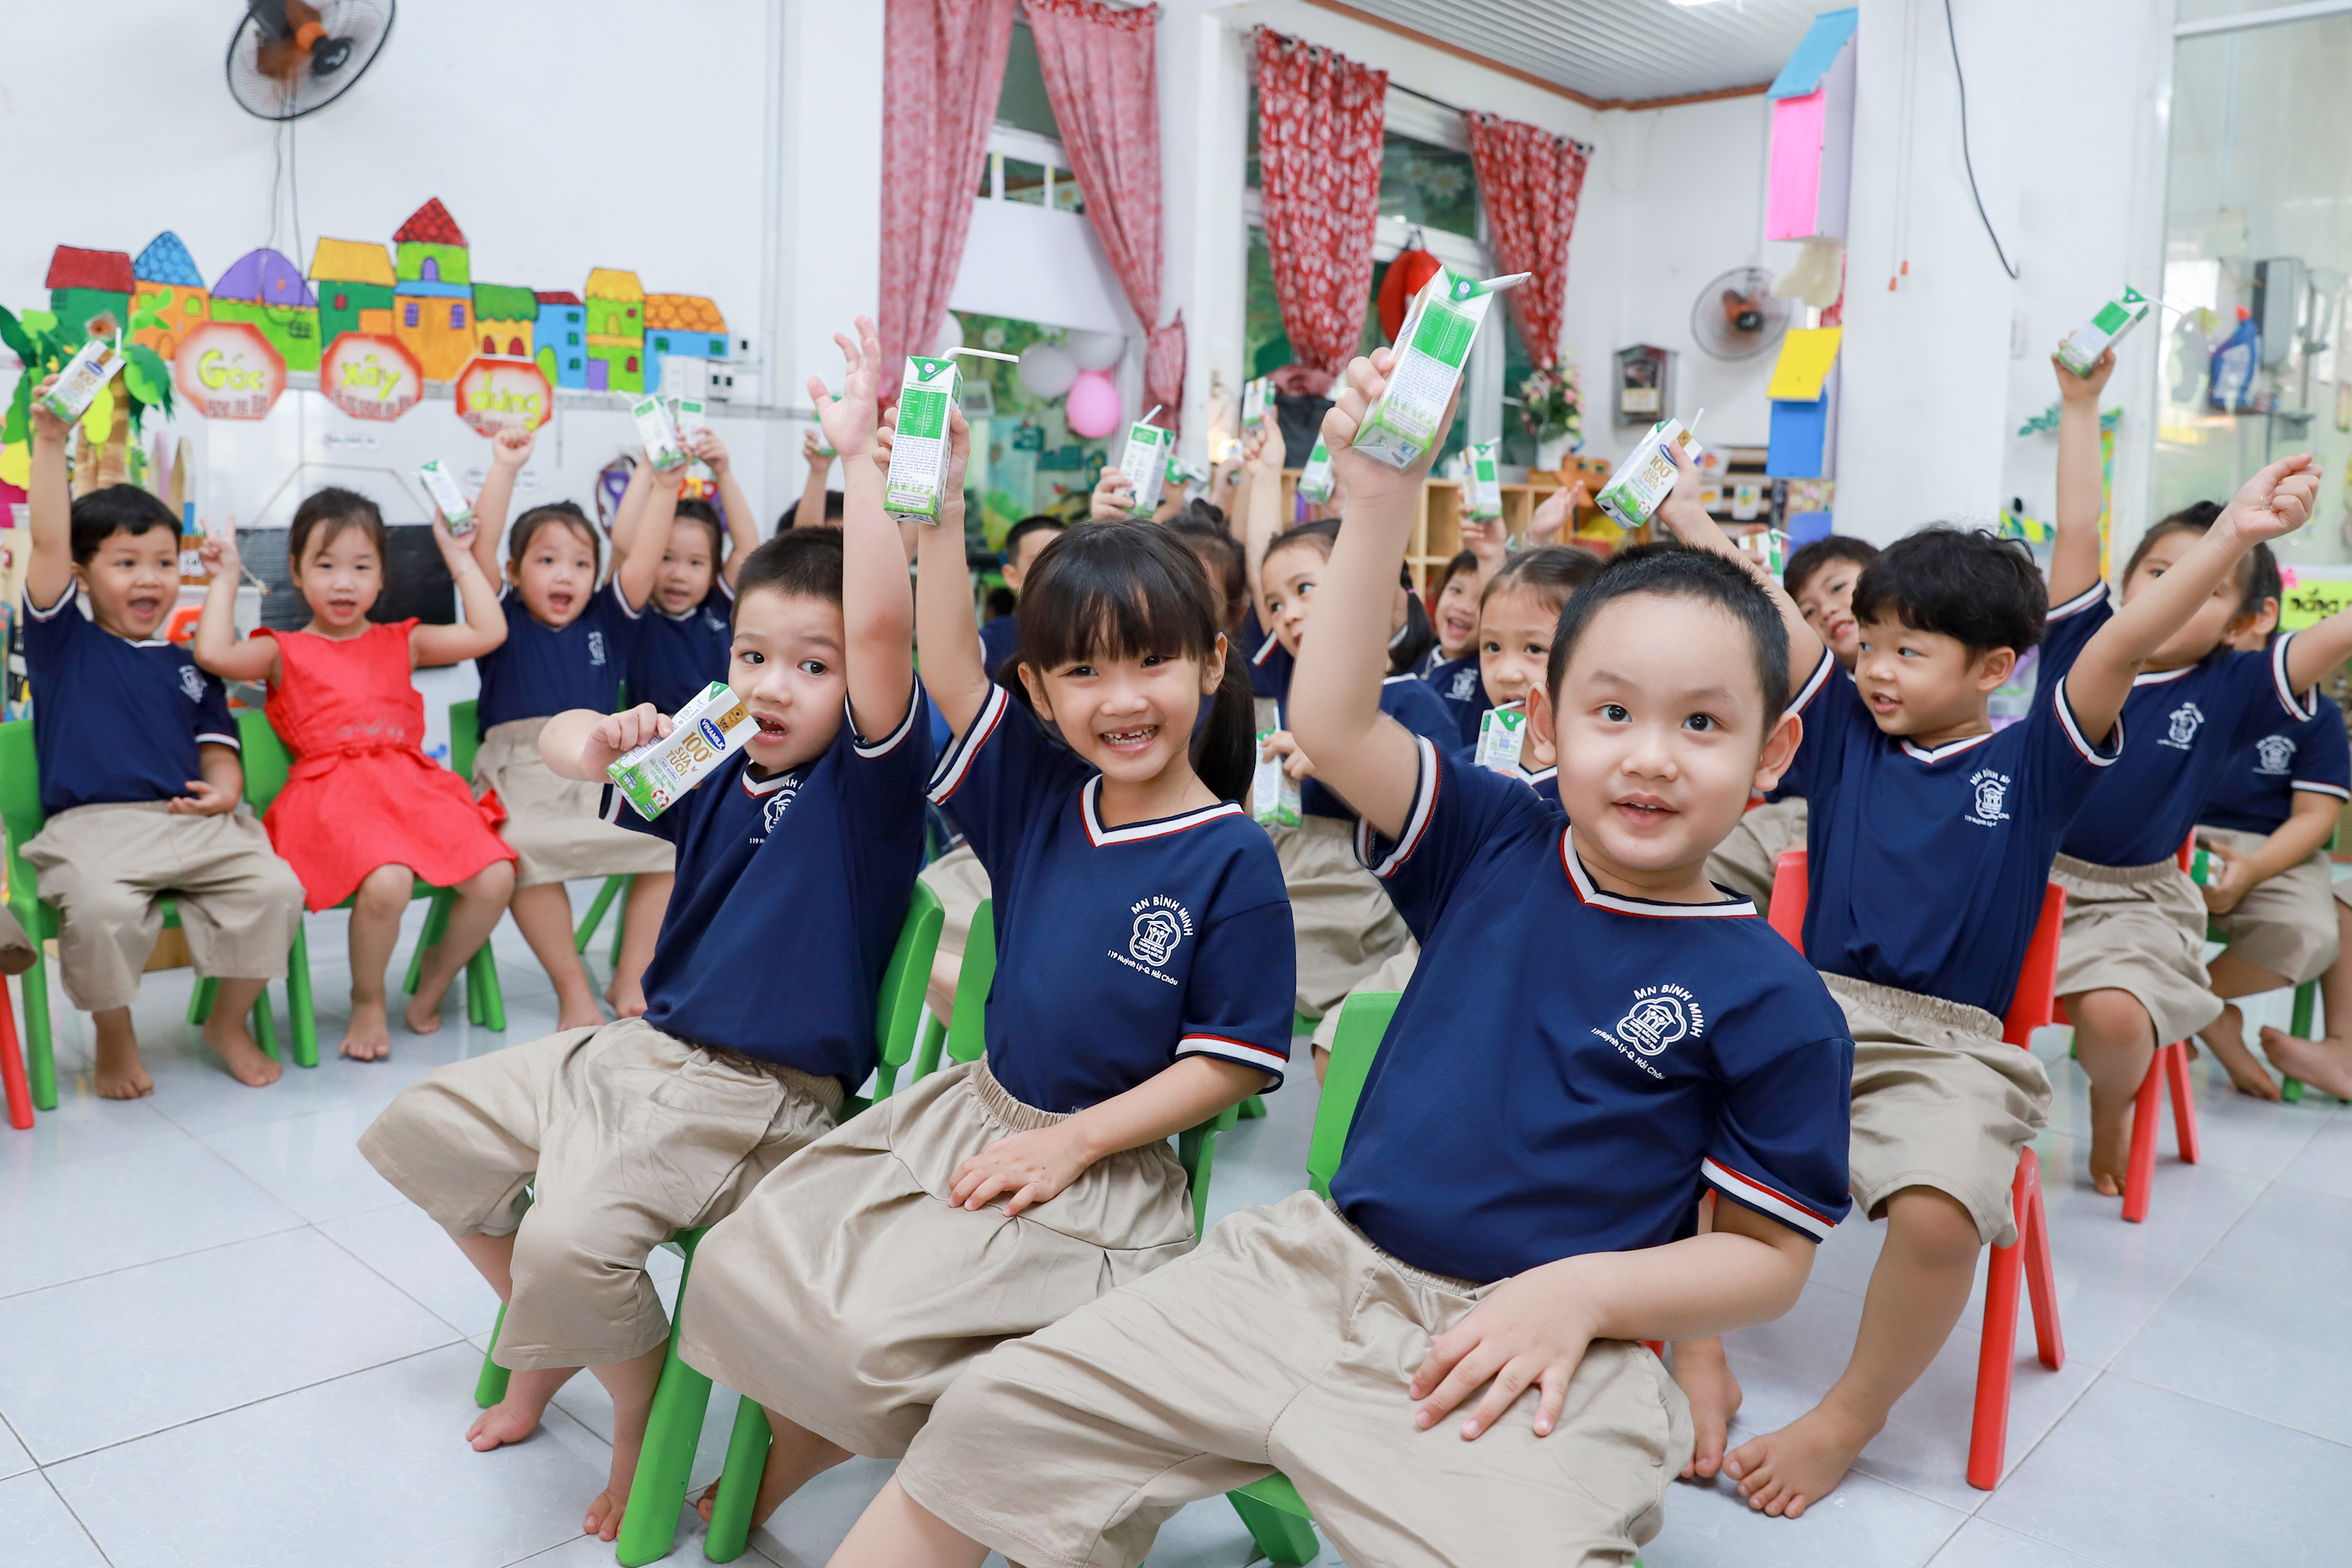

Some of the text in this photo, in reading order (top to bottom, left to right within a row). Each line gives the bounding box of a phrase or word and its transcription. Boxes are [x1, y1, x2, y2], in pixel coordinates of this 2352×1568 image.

[197, 348, 265, 391] Góc
[342, 354, 402, 402] xây
[700, 719, 725, 750] VINAMILK
[674, 746, 691, 767] SỮA
[623, 774, 631, 784] 180
[783, 779, 798, 788] NH
[1131, 894, 1194, 936] MN BÌNH MINH
[1107, 950, 1118, 959] 119
[1117, 955, 1135, 968] Huỳnh
[1151, 970, 1162, 979] Hải
[1161, 974, 1178, 985] Châu
[1633, 983, 1704, 1037] MN BÌNH MINH
[1635, 1056, 1649, 1070] Hải
[1646, 1066, 1665, 1080] Châu
